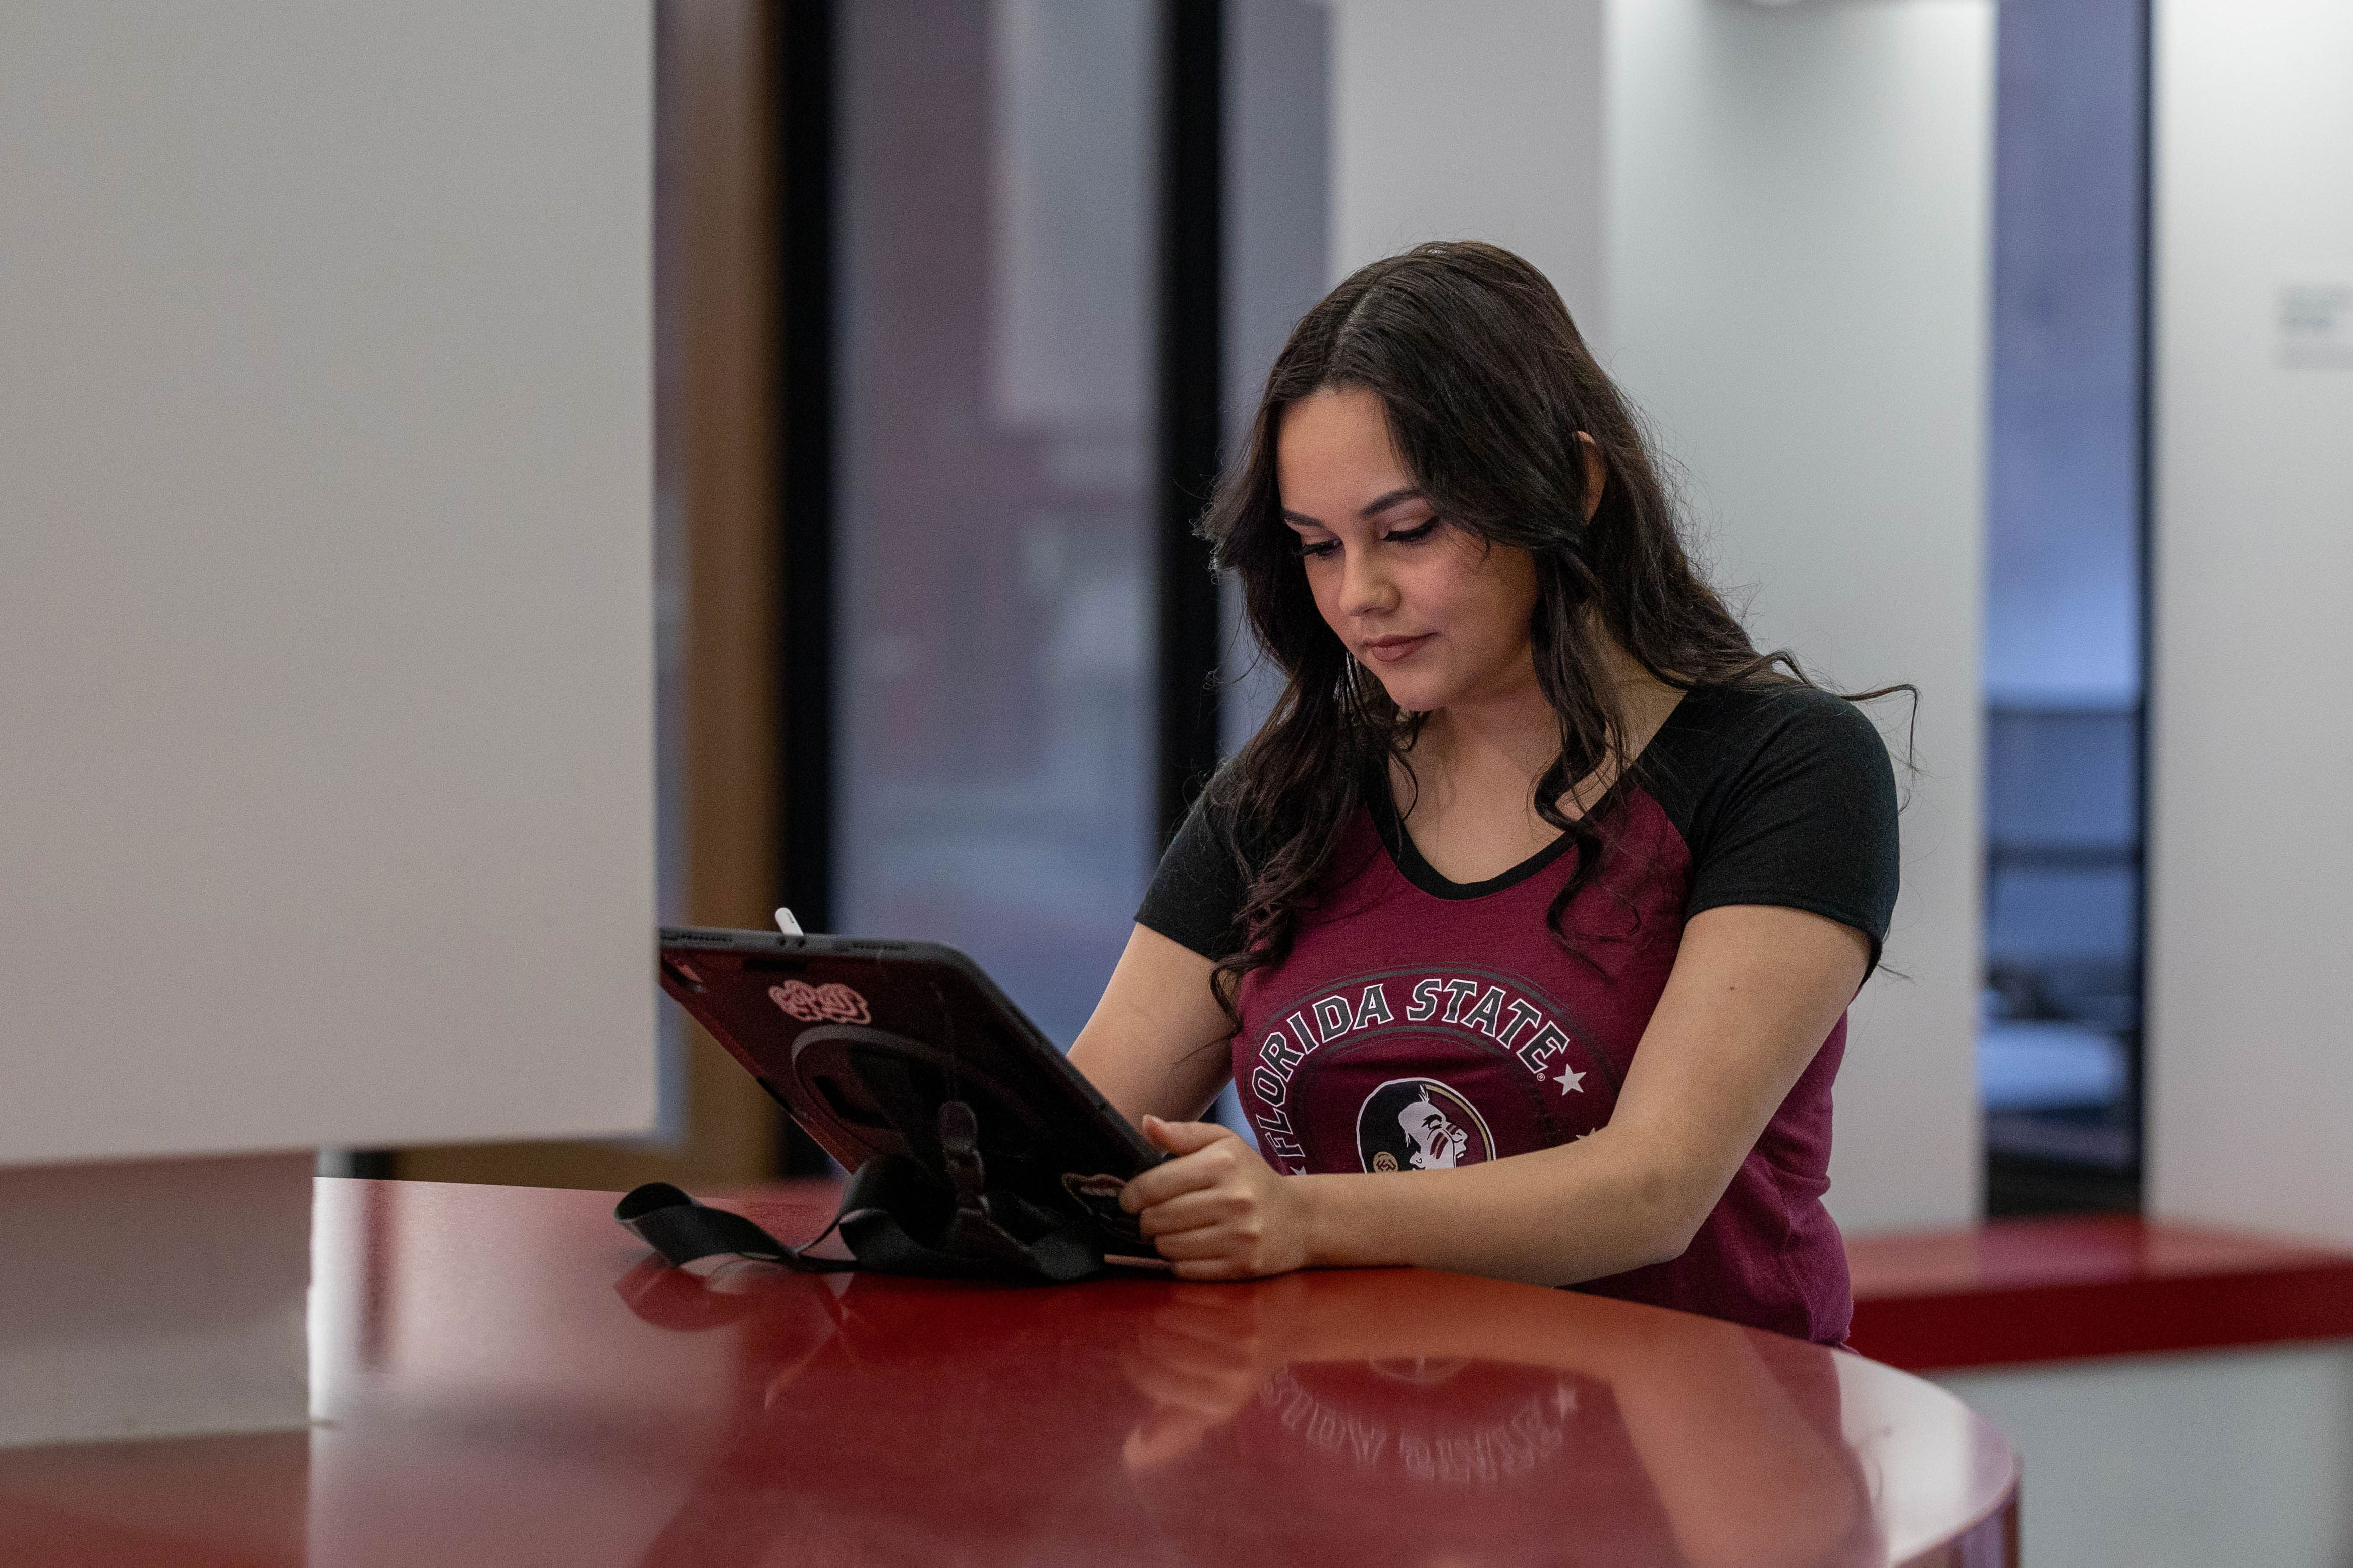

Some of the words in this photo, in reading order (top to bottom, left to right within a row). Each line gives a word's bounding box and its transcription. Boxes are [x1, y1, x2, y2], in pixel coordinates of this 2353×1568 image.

[1252, 983, 1394, 1158] FLORIDA
[1406, 978, 1570, 1074] STATE
[1376, 1159, 1397, 1172] FSU
